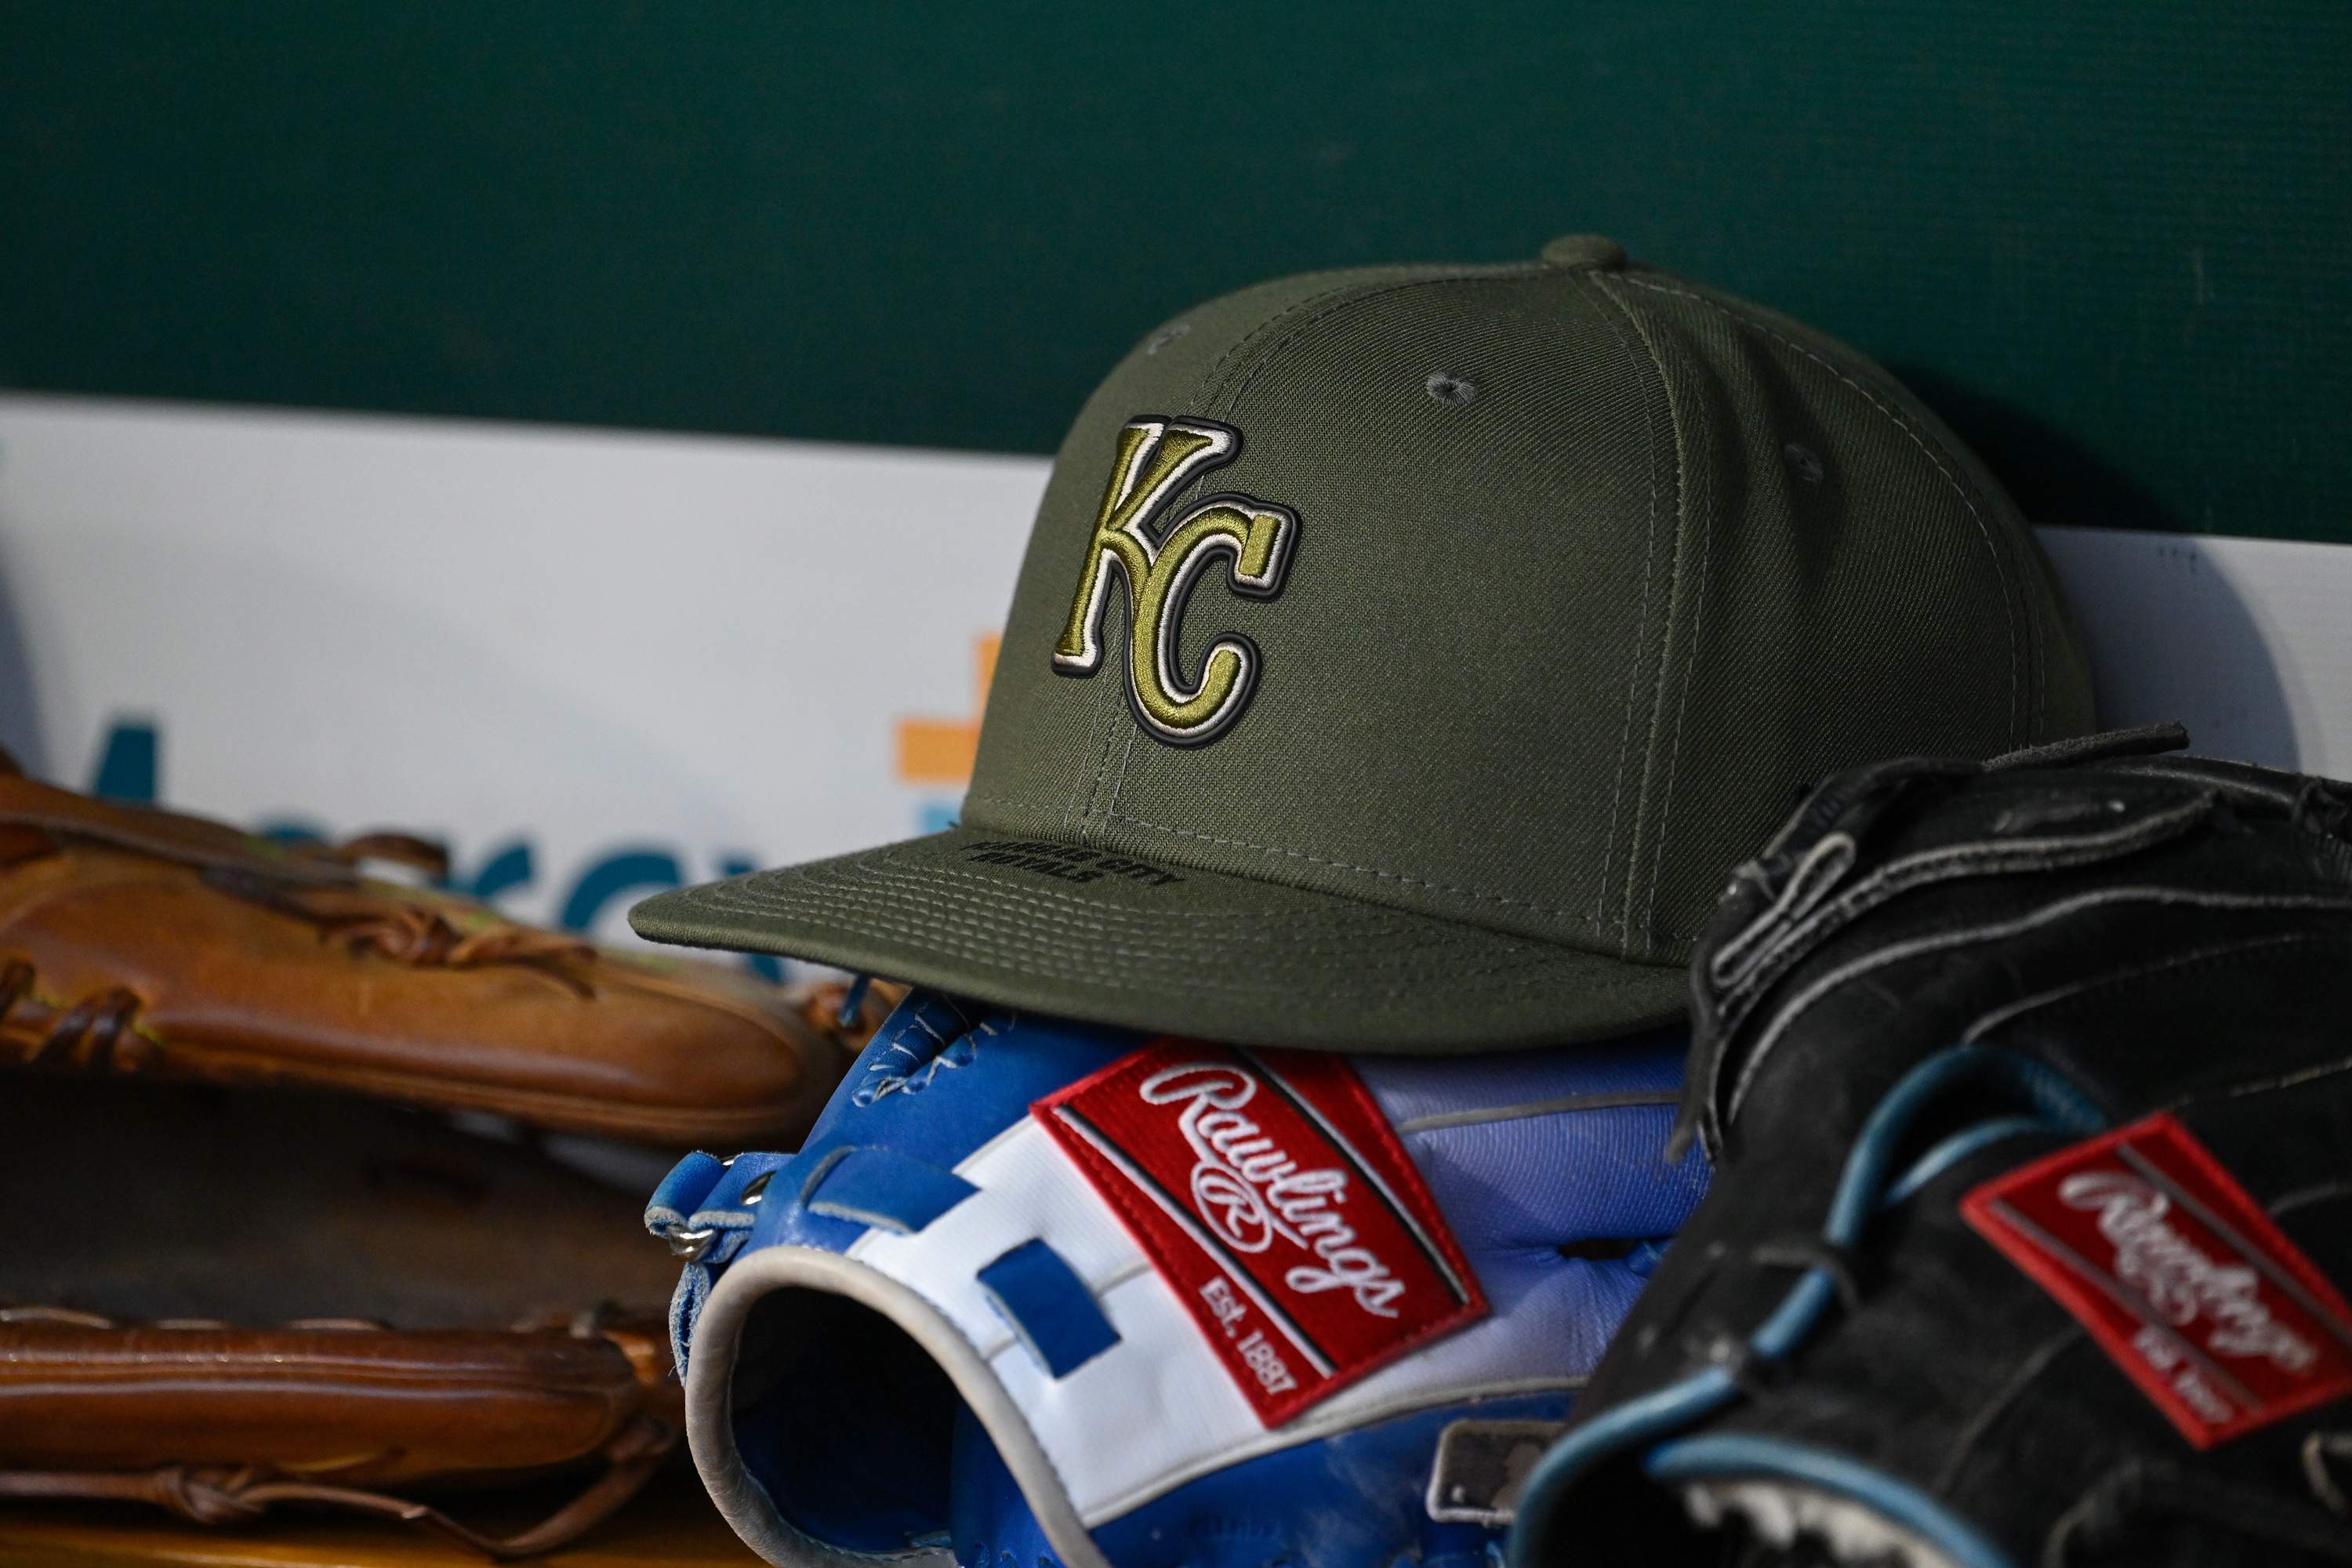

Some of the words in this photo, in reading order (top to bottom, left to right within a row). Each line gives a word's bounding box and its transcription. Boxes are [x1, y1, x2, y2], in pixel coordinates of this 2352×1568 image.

[1051, 415, 1303, 749] KC
[1139, 1062, 1405, 1319] Rawlings
[1198, 1276, 1247, 1338] Est.
[1236, 1329, 1298, 1396] 1887
